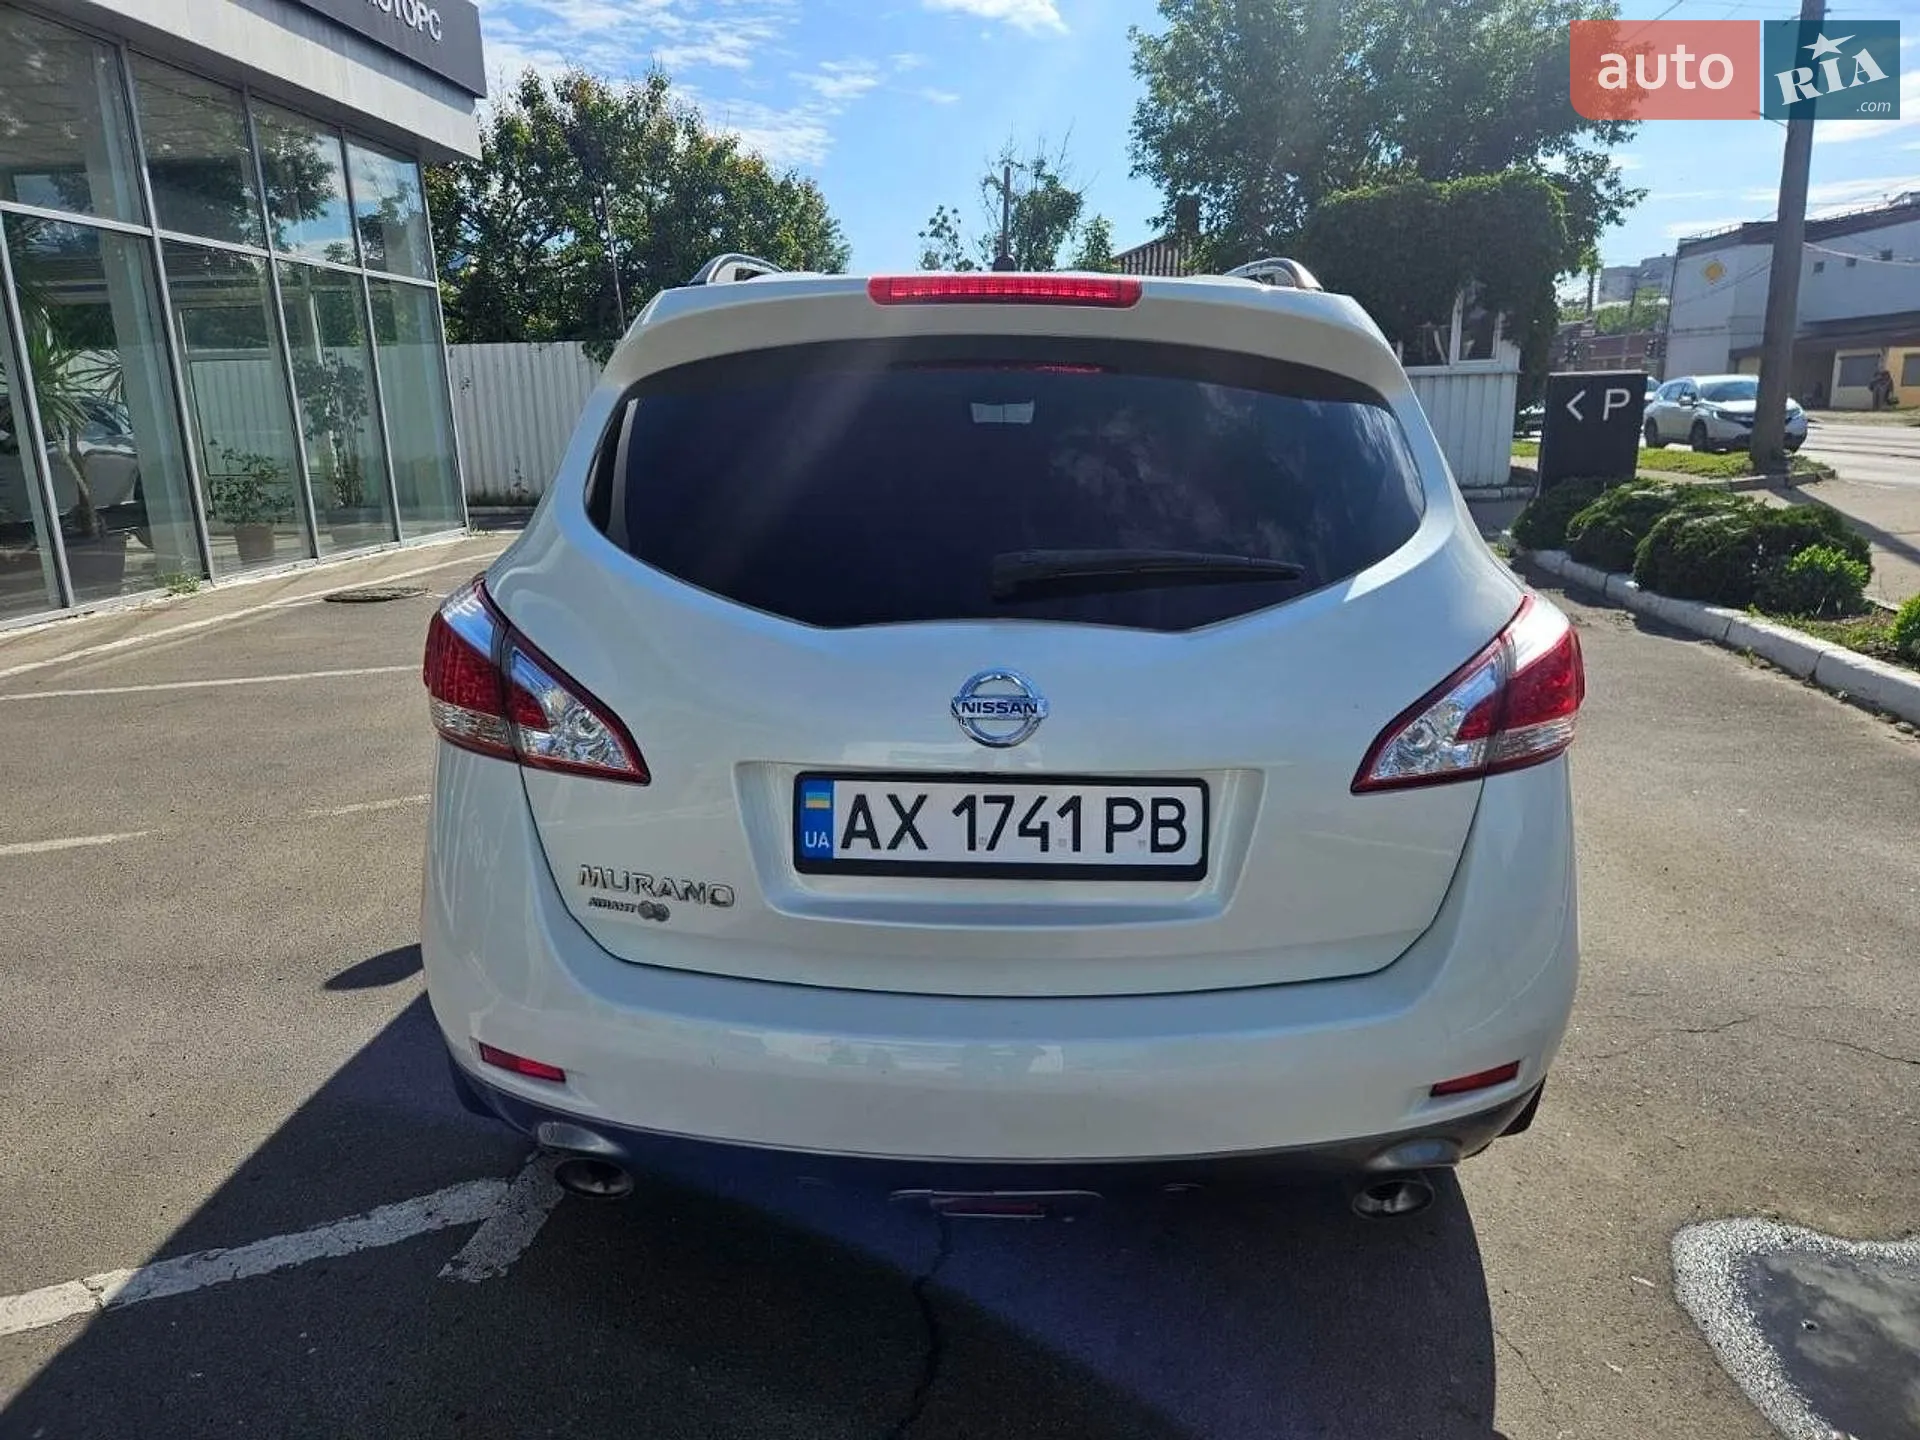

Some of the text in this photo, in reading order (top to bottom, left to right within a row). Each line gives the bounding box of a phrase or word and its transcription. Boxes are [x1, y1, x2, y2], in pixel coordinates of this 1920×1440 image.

[1603, 388, 1631, 421] P
[961, 701, 1038, 714] NISSAN
[804, 832, 830, 848] UA
[840, 794, 1188, 853] AX 1741 PB
[579, 864, 735, 907] MURANO
